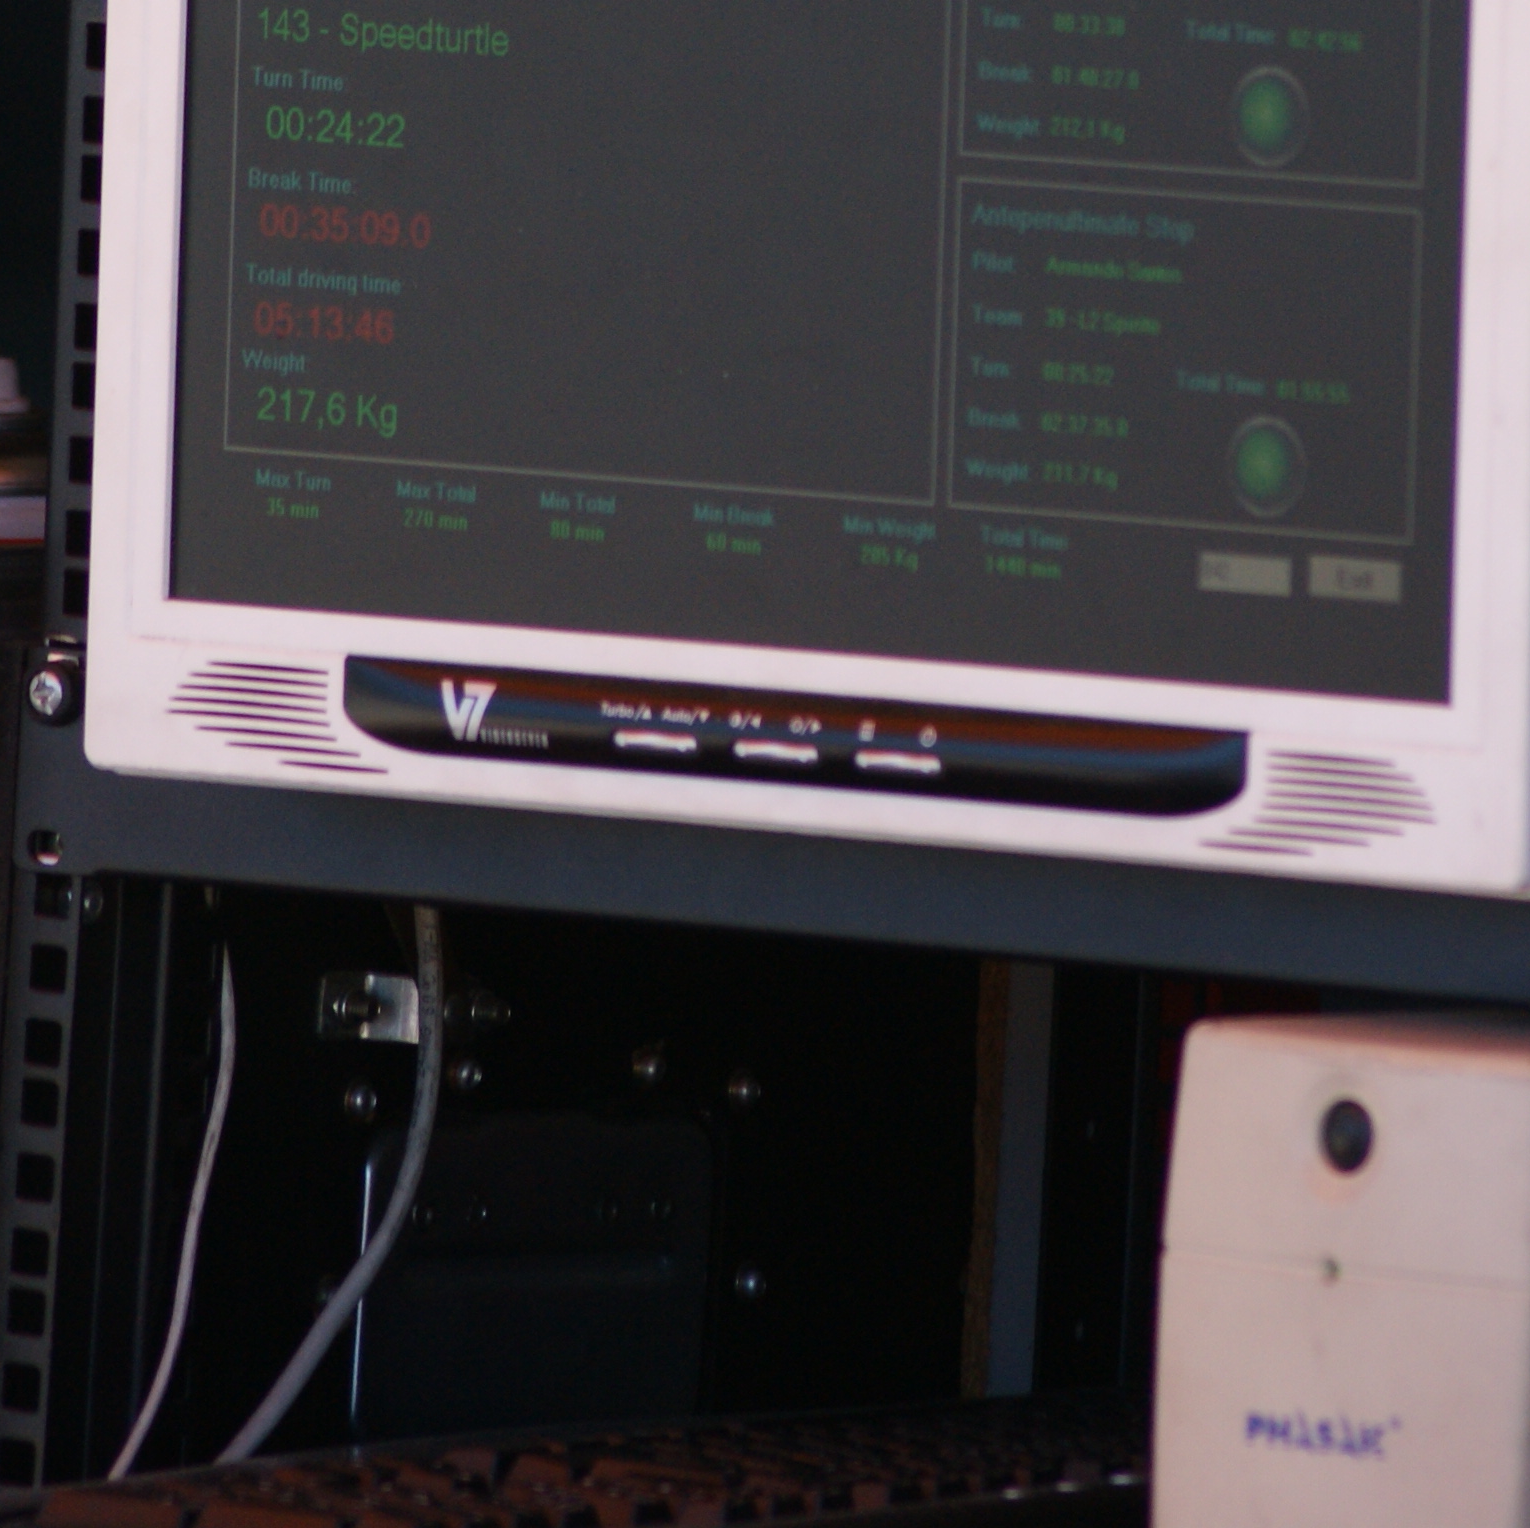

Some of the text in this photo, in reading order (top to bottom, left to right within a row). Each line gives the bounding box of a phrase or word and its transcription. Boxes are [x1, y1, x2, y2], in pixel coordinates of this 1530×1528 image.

[259, 8, 309, 43] 143
[339, 12, 509, 57] Speedturtle
[253, 66, 292, 88] Turn
[265, 105, 405, 148] 00:24:22
[248, 168, 300, 190] Break
[260, 203, 431, 249] 00:35:09.0
[246, 263, 291, 286] Total
[297, 269, 358, 295] driving
[254, 301, 394, 344] 05:13:46
[257, 386, 397, 438] 217,6 Kg
[254, 469, 331, 490] Max Turn
[396, 481, 476, 503] Max Total
[289, 504, 319, 517] min
[540, 492, 615, 515] Min Total
[438, 516, 468, 529] min
[441, 679, 498, 742] V7
